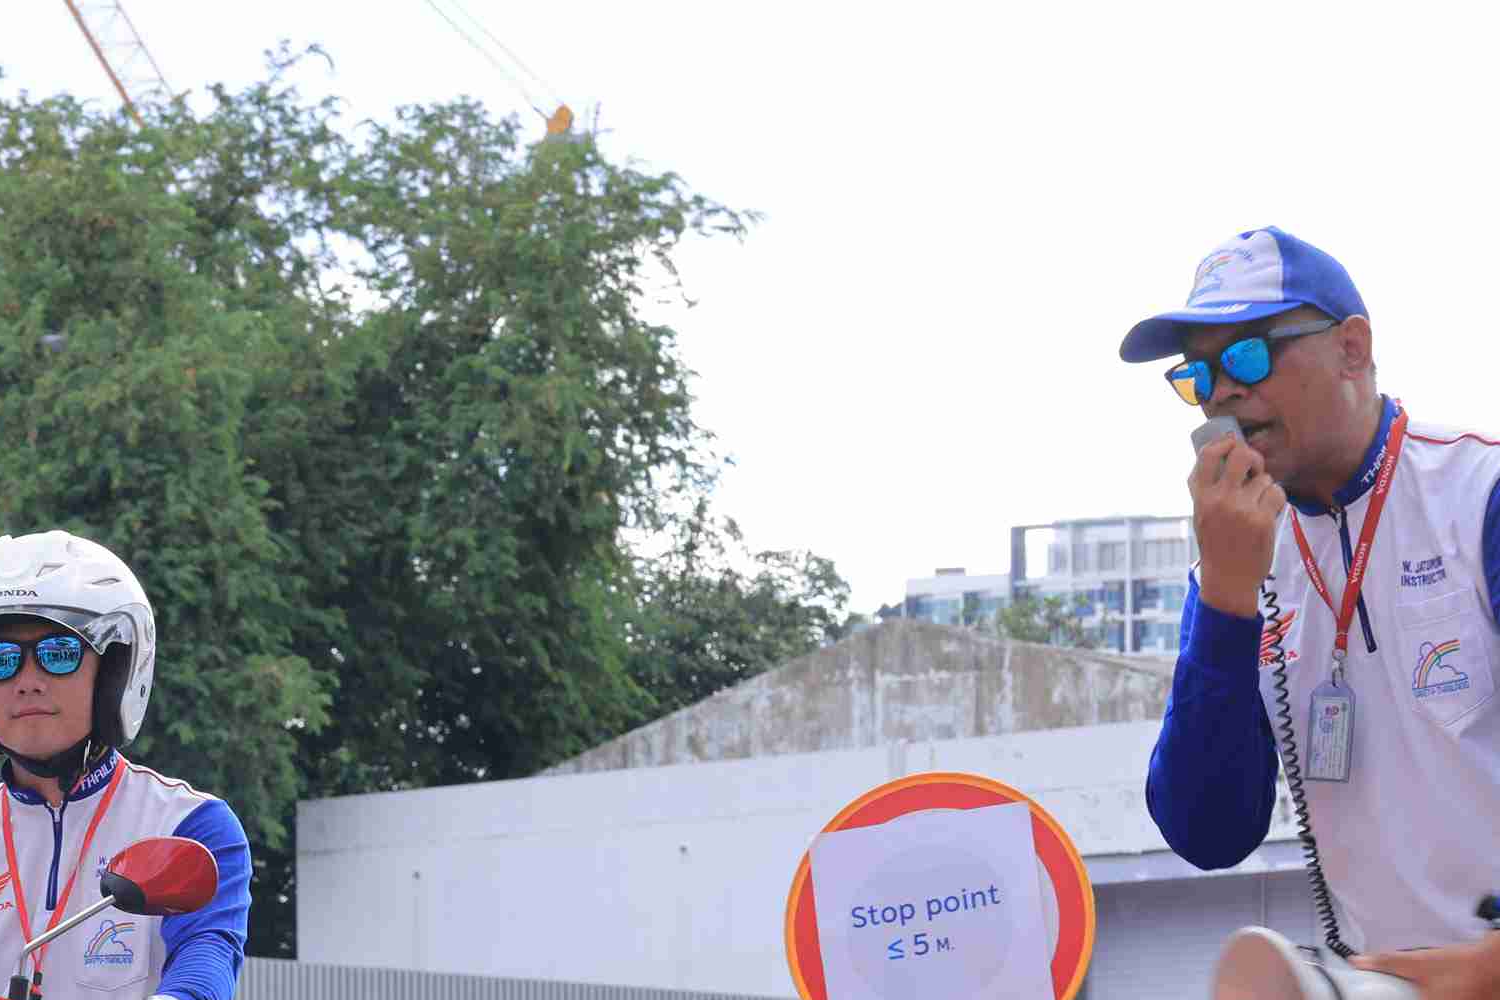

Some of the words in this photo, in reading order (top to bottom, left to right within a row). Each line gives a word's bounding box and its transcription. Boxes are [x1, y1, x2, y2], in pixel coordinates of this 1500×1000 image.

[1376, 454, 1396, 495] HONDA
[1350, 543, 1367, 585] HONDA
[851, 903, 916, 929] Stop
[926, 884, 1001, 921] point
[913, 932, 930, 956] 5
